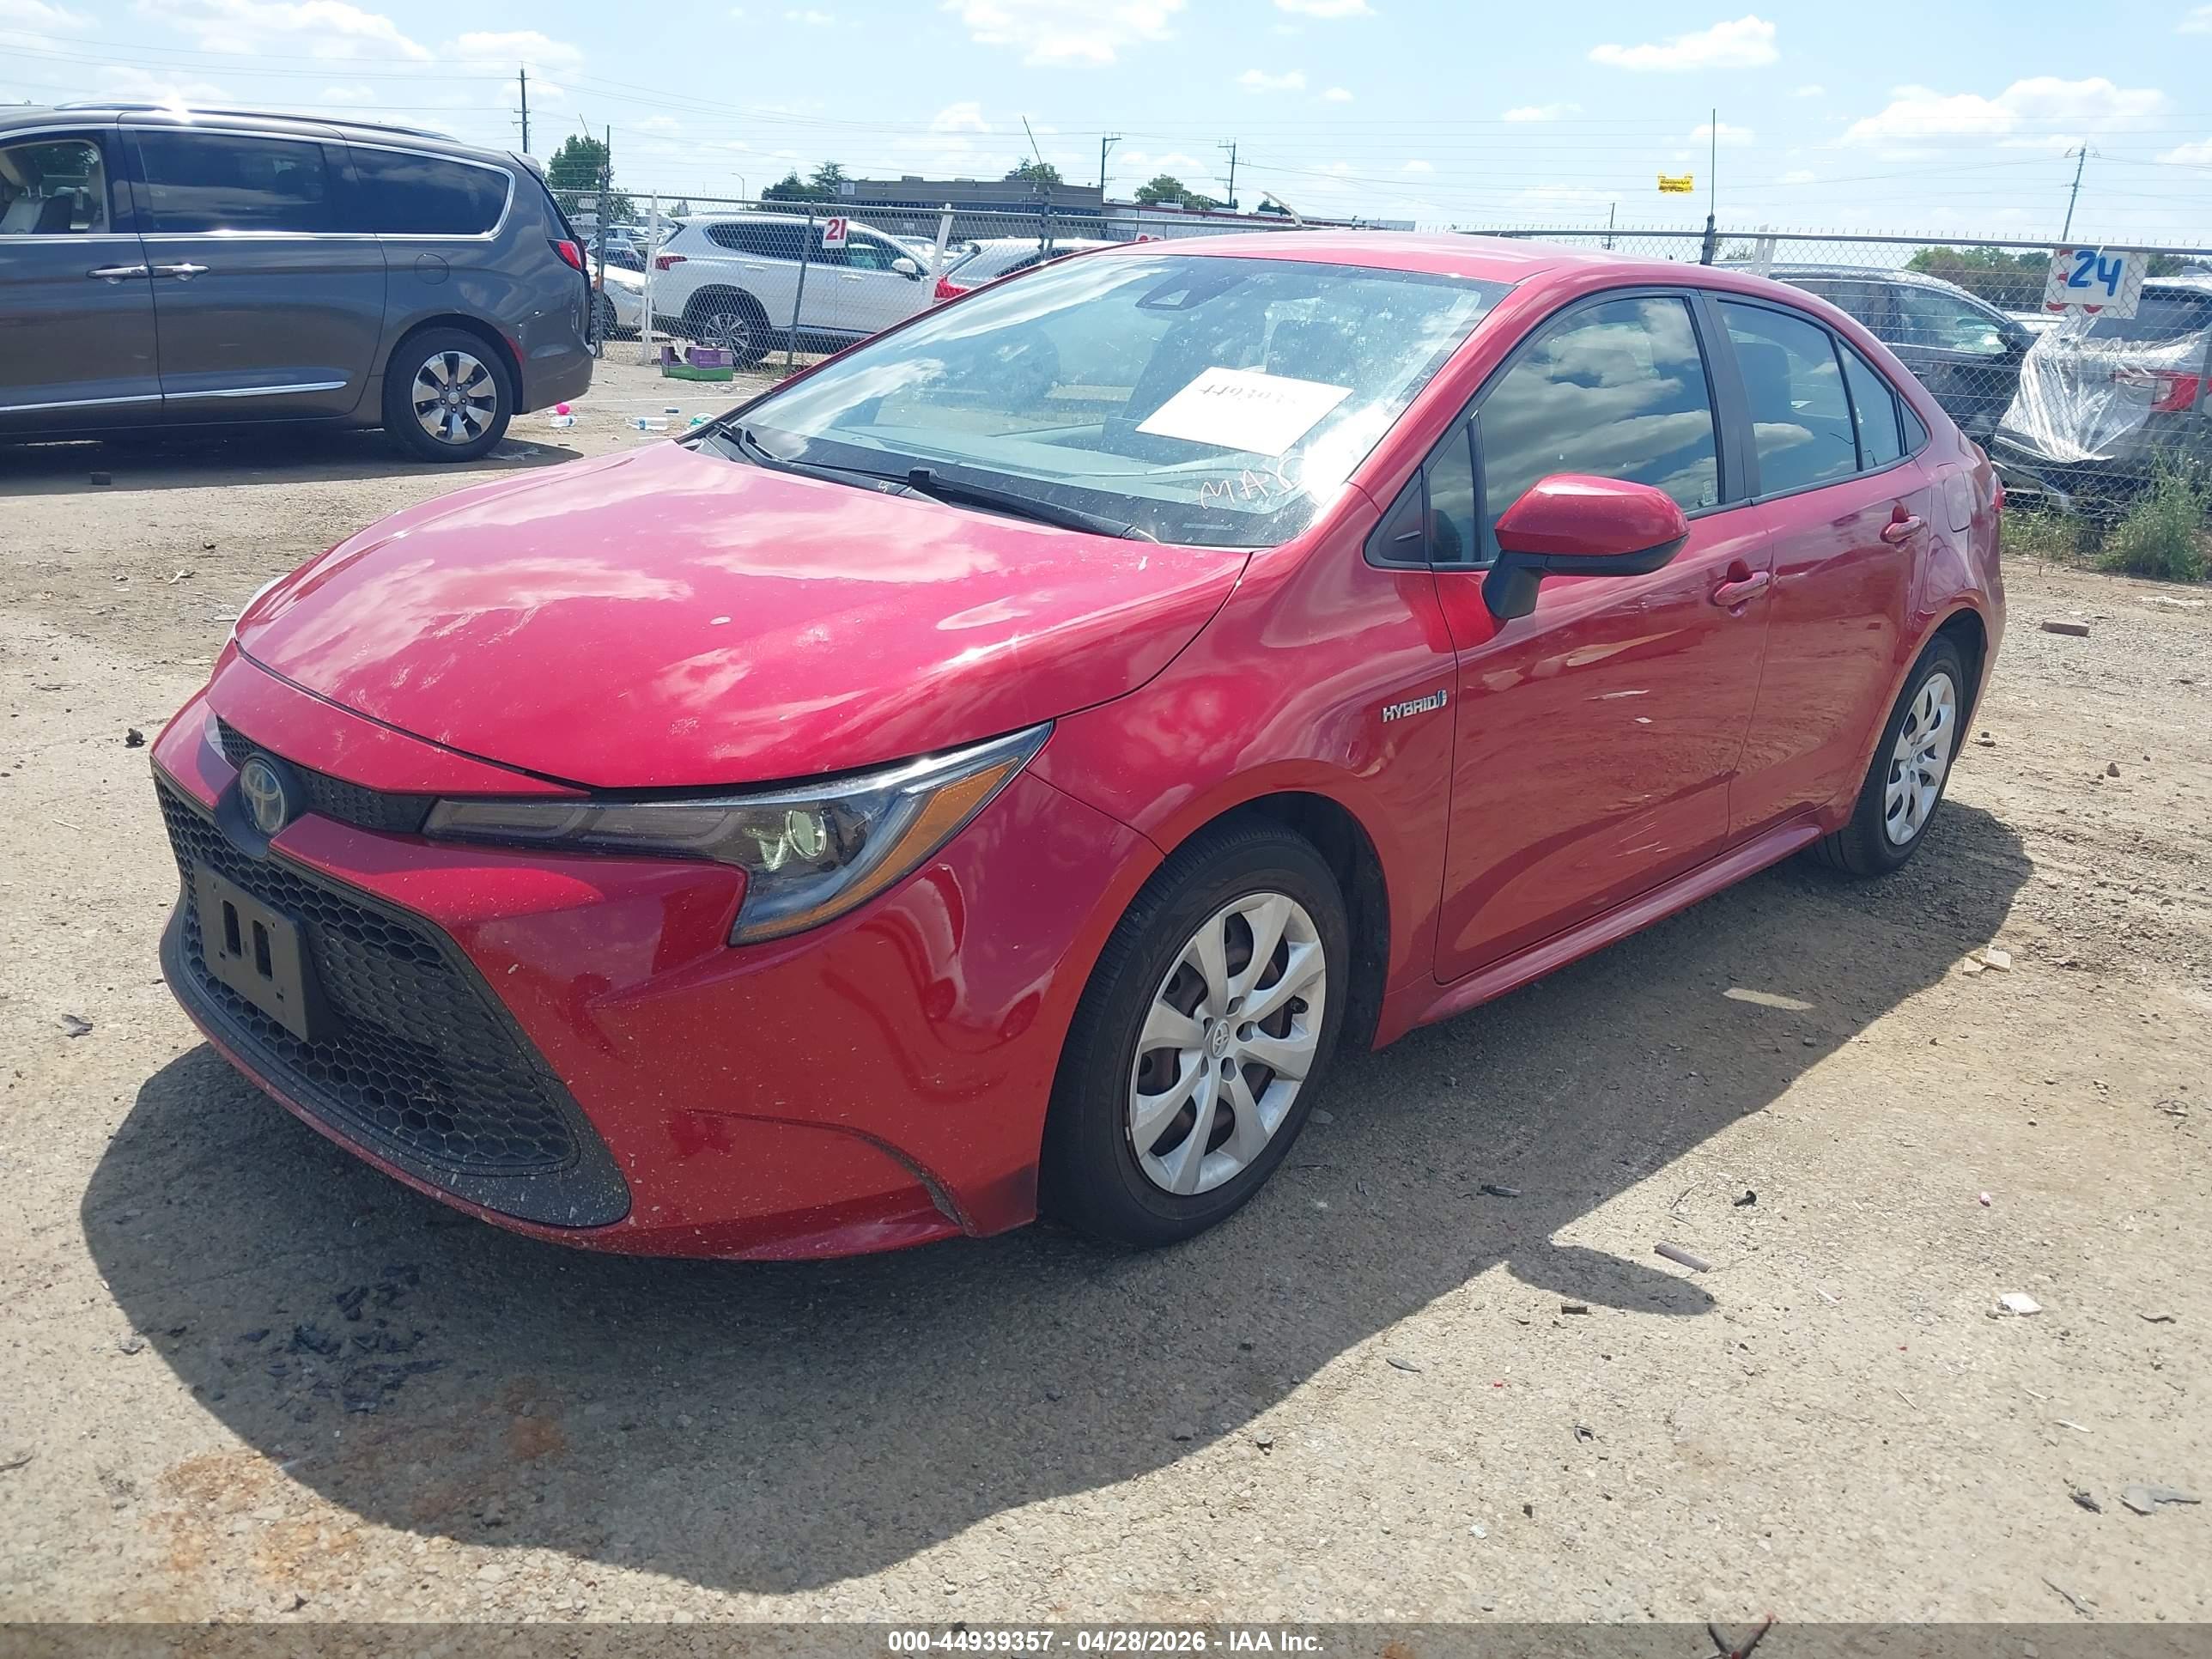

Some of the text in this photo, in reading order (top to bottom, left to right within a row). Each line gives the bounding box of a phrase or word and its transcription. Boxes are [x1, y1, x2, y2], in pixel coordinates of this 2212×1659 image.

[825, 218, 847, 240] 21
[2067, 250, 2123, 297] 24
[1382, 695, 1439, 723] HYBRID
